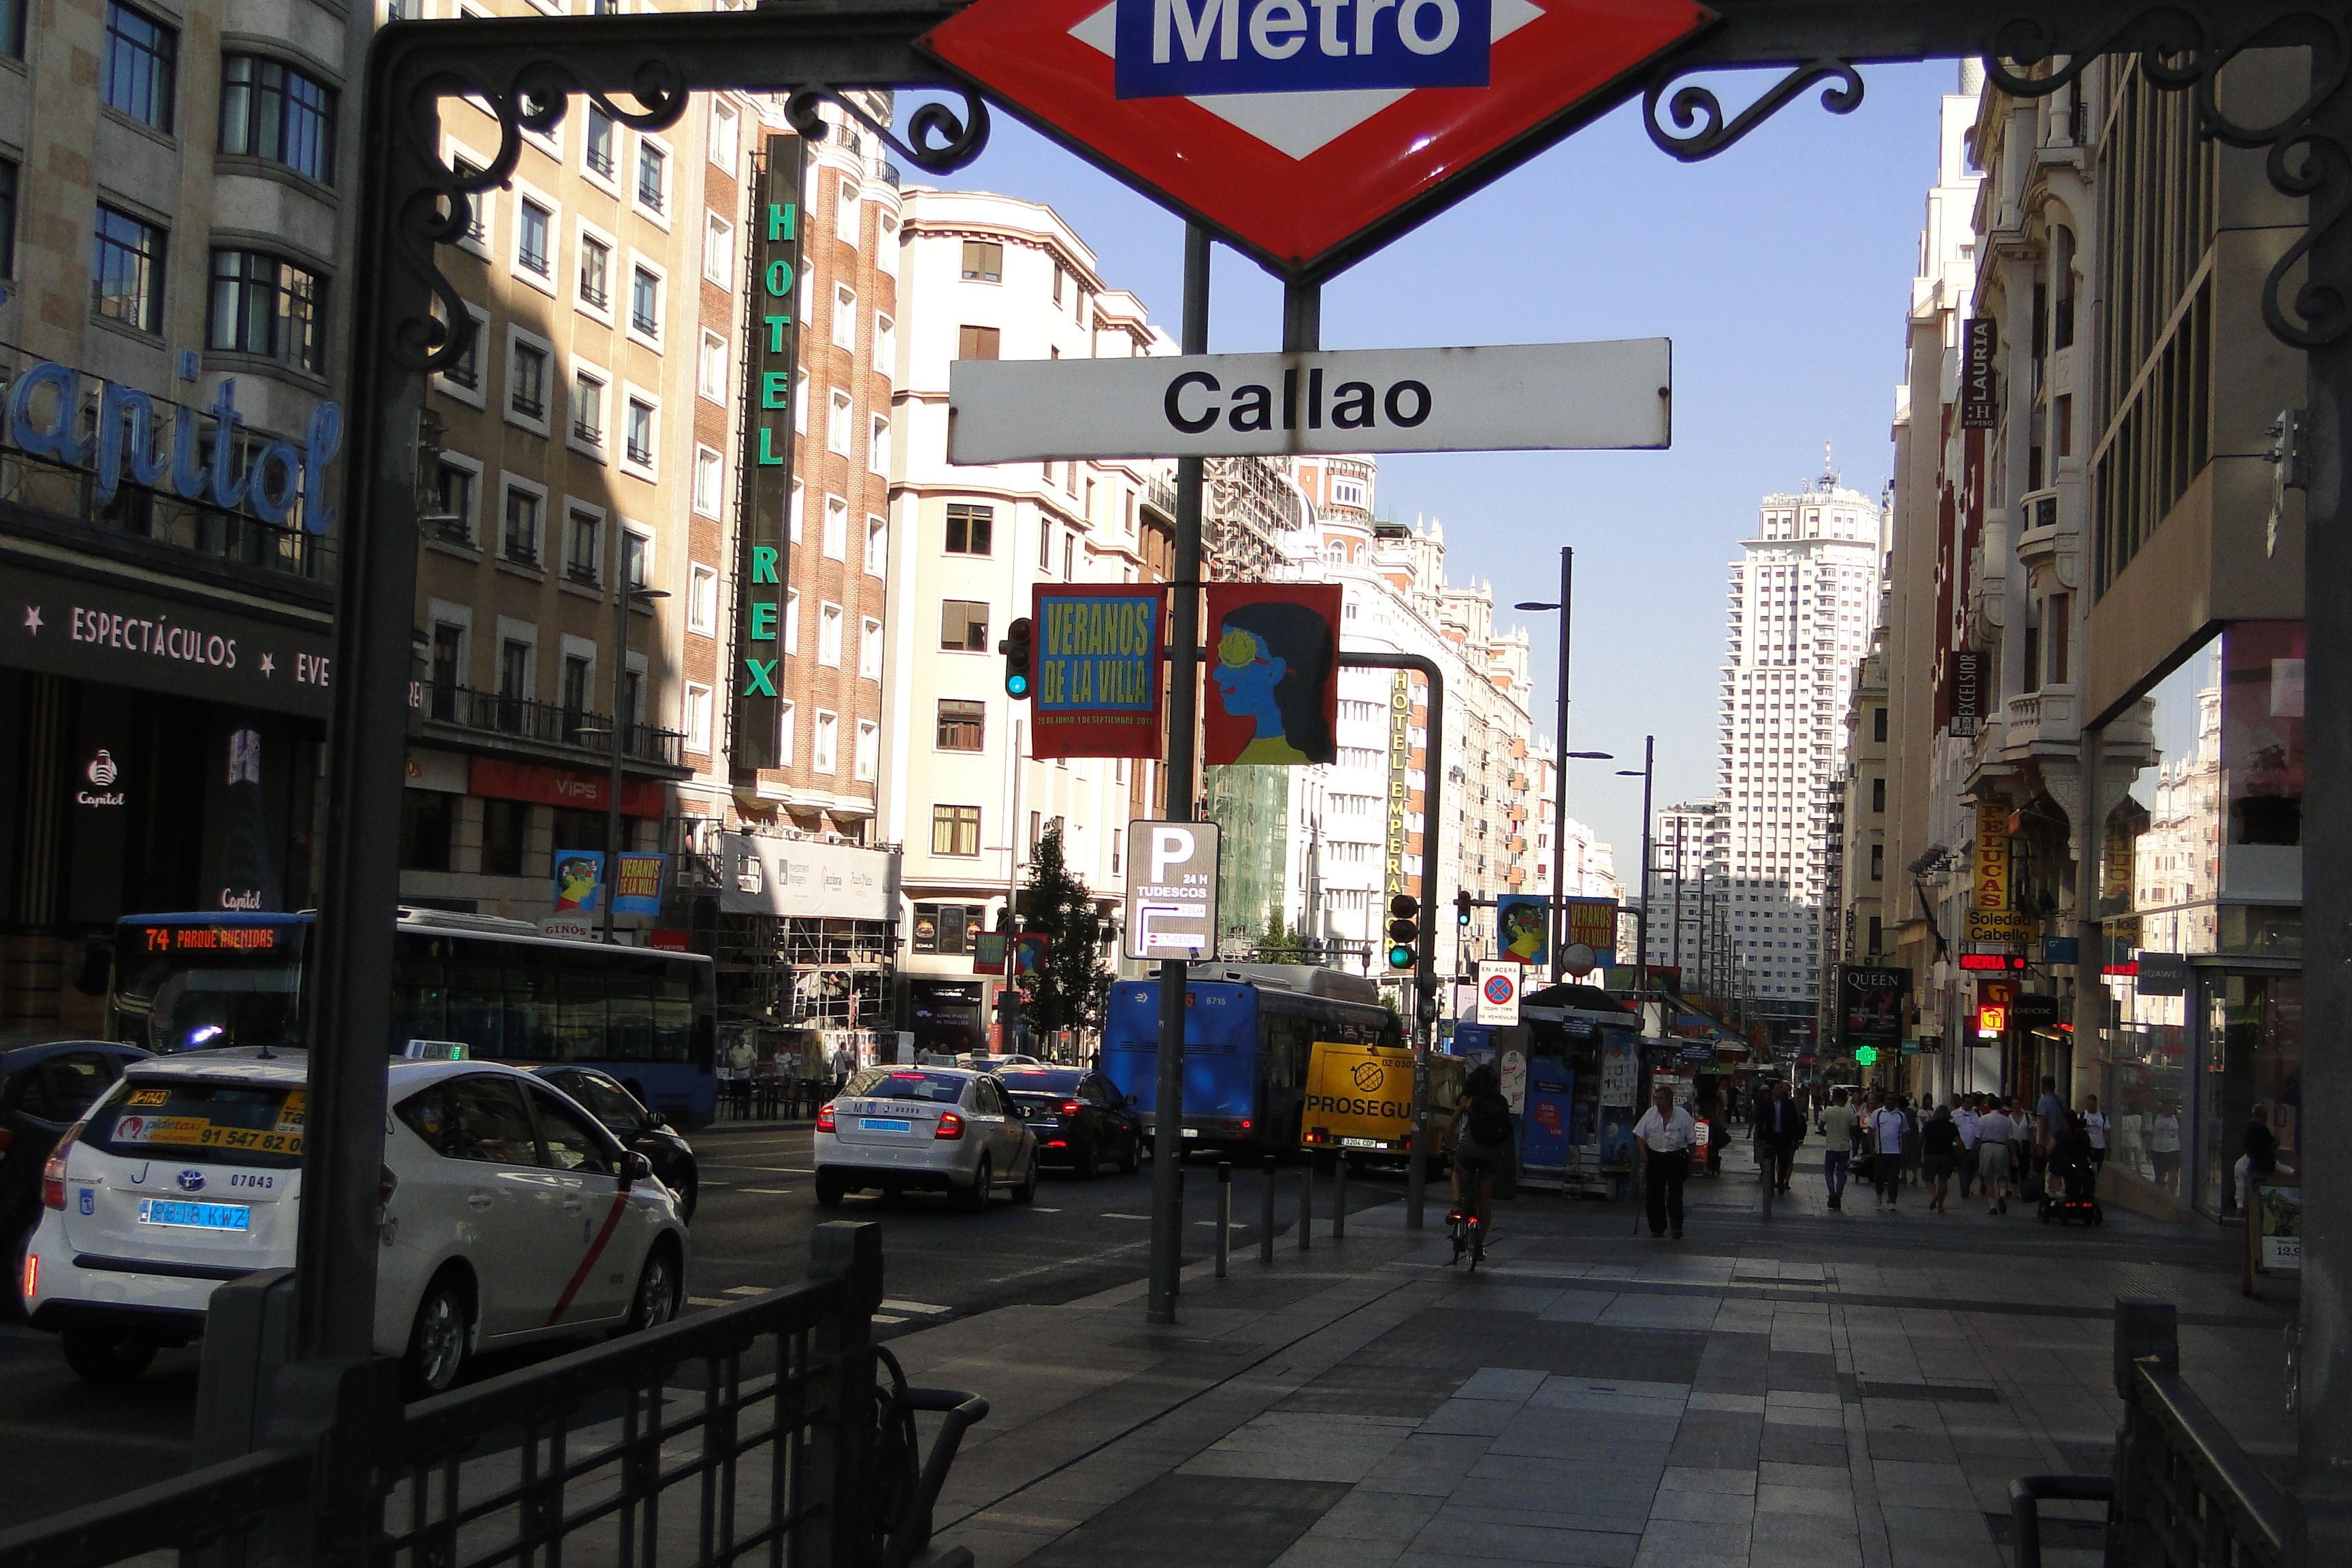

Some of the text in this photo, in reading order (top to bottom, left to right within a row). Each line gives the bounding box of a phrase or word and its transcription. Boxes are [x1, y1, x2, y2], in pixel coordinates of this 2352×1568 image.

[1152, 0, 1460, 63] Metro
[1972, 323, 1988, 402] LAURIA
[1163, 368, 1434, 434] Callao
[0, 348, 344, 536] apitol
[743, 203, 796, 699] HOTEL REX
[71, 605, 237, 670] ESPECTÁCULOS
[1047, 602, 1149, 657] VERANOS
[1044, 659, 1147, 704] DE LA VILLA
[1959, 654, 1977, 716] EXCELSIOR
[1392, 672, 1409, 771] HOTEL
[78, 790, 126, 808] Capitol
[555, 778, 597, 800] VIPS
[1151, 826, 1195, 884] P
[1979, 805, 2005, 906] PELUCAS
[621, 859, 661, 879] VERANOS
[1183, 873, 1208, 885] 24 H
[628, 878, 637, 894] LA
[638, 878, 657, 895] VILLA
[1137, 885, 1207, 898] TUDESCOS
[221, 887, 261, 911] Capitol
[1571, 904, 1612, 928] VERANOS
[1969, 912, 2031, 926] Soledad
[146, 928, 171, 951] 74
[177, 928, 218, 948] PARQUE
[545, 925, 587, 936] GINOS
[1591, 928, 1612, 947] VILLA
[1971, 927, 2029, 941] Cabello
[653, 943, 686, 951] VIPS
[1847, 971, 1899, 992] QUEEN
[853, 1102, 863, 1113] M
[1305, 1094, 1411, 1119] PROSEGU
[201, 1129, 222, 1144] 91
[226, 1130, 260, 1147] 547
[263, 1134, 285, 1150] 82
[231, 1174, 274, 1189] 07043
[207, 1207, 246, 1228] KWZ
